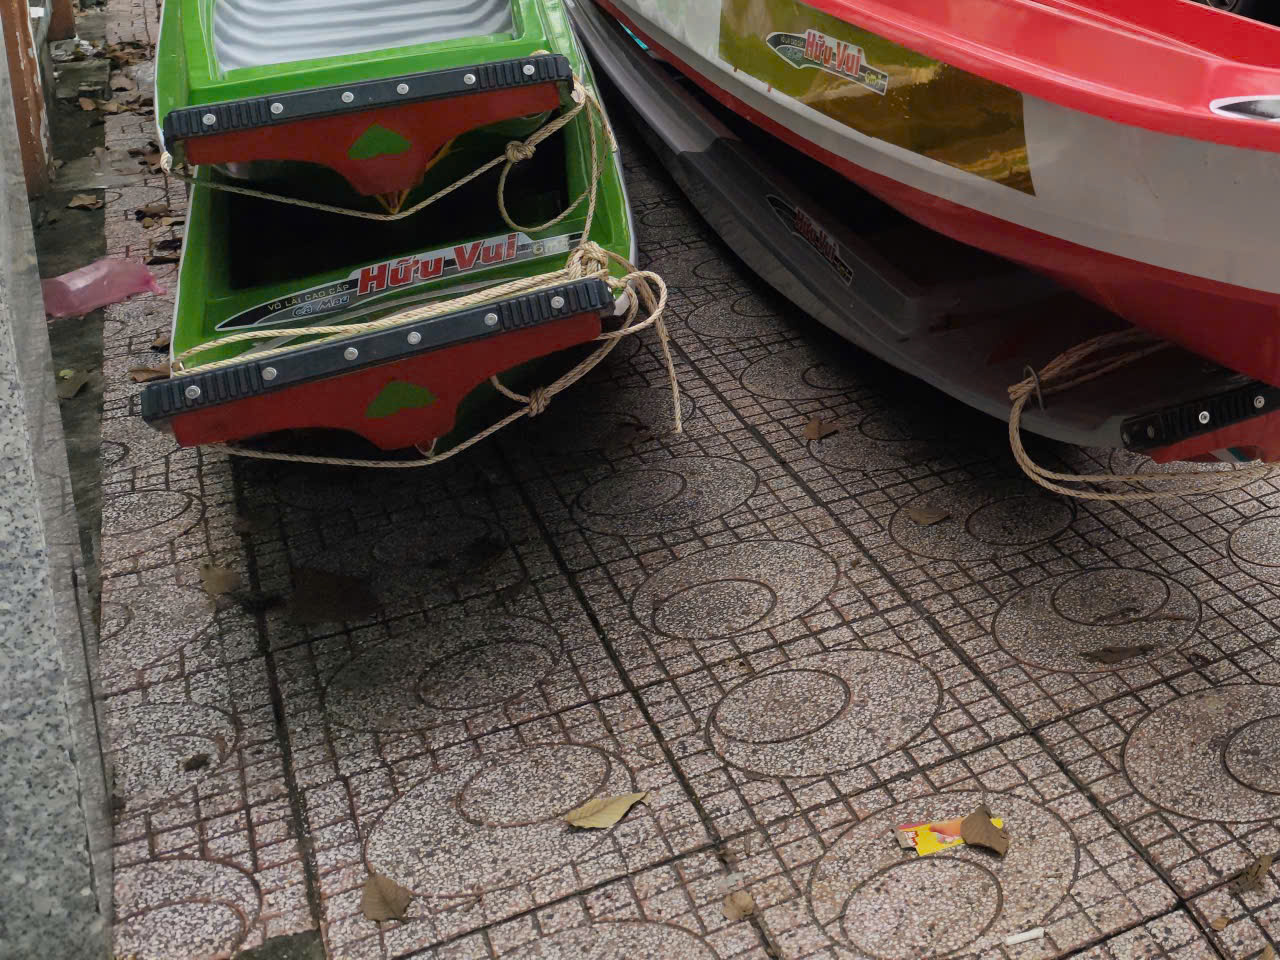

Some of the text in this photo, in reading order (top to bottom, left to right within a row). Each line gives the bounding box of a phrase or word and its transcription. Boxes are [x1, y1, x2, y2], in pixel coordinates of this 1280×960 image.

[357, 255, 445, 296] Hữu
[452, 232, 517, 271] Vui
[304, 290, 326, 301] CAO
[328, 283, 349, 295] CẤP
